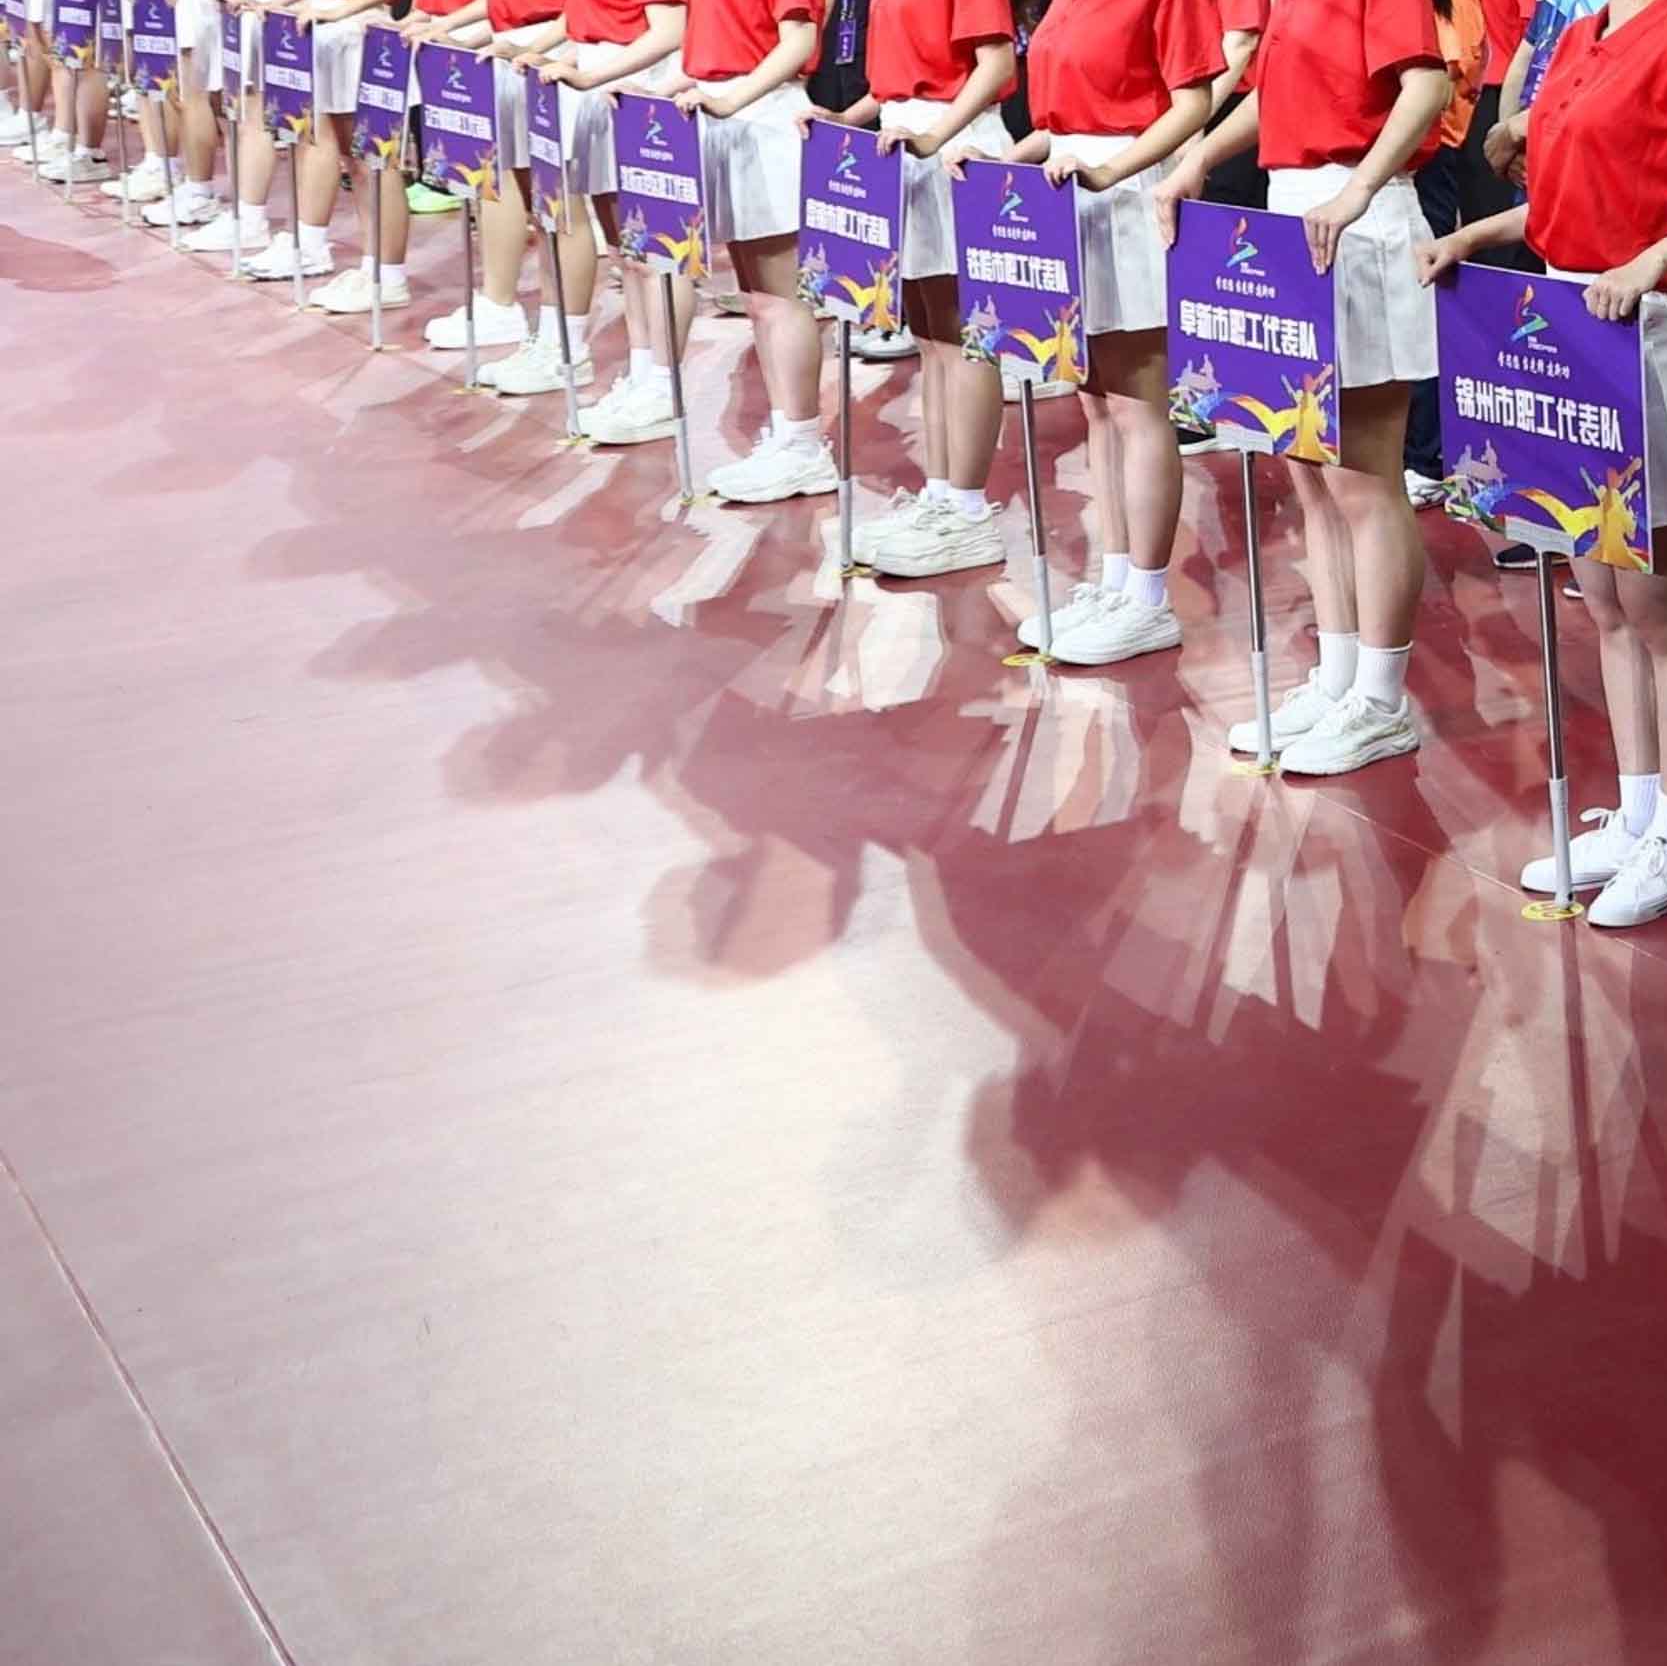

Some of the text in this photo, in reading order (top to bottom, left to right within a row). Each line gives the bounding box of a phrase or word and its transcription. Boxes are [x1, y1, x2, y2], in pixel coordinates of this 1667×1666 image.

[1455, 375, 1624, 454] 锦州市职工代表队
